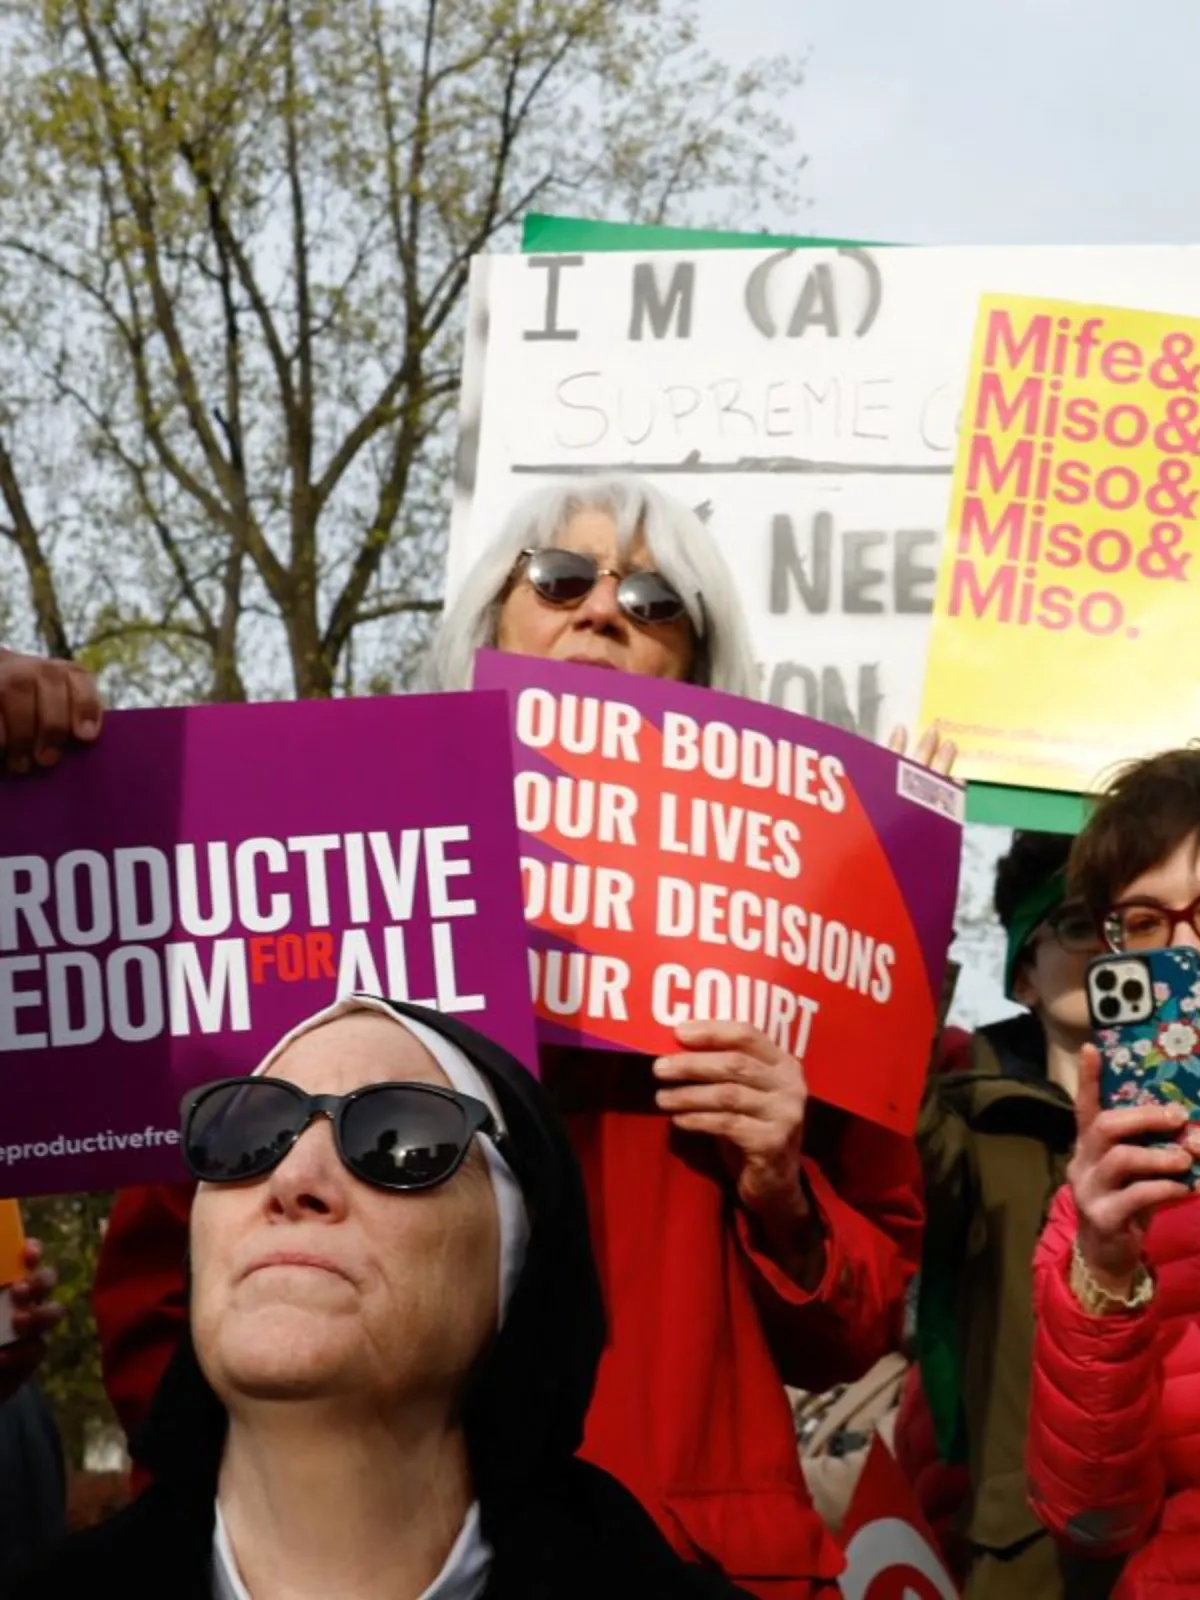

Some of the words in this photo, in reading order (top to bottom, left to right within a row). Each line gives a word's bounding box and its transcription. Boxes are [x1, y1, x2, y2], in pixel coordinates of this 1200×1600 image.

[523, 255, 584, 341] I
[628, 262, 696, 341] M
[555, 370, 895, 449] SUPREME
[965, 433, 1200, 521] Miso&
[956, 495, 1192, 582] Miso&
[947, 558, 1141, 640] Miso.
[516, 687, 641, 764] OUR
[662, 711, 845, 814] BODIES
[513, 770, 639, 846] OUR
[659, 791, 800, 879] LIVES
[249, 933, 335, 985] FOR
[336, 922, 486, 1013] ALL
[656, 875, 896, 1004] DECISIONS
[652, 963, 819, 1060] COURT
